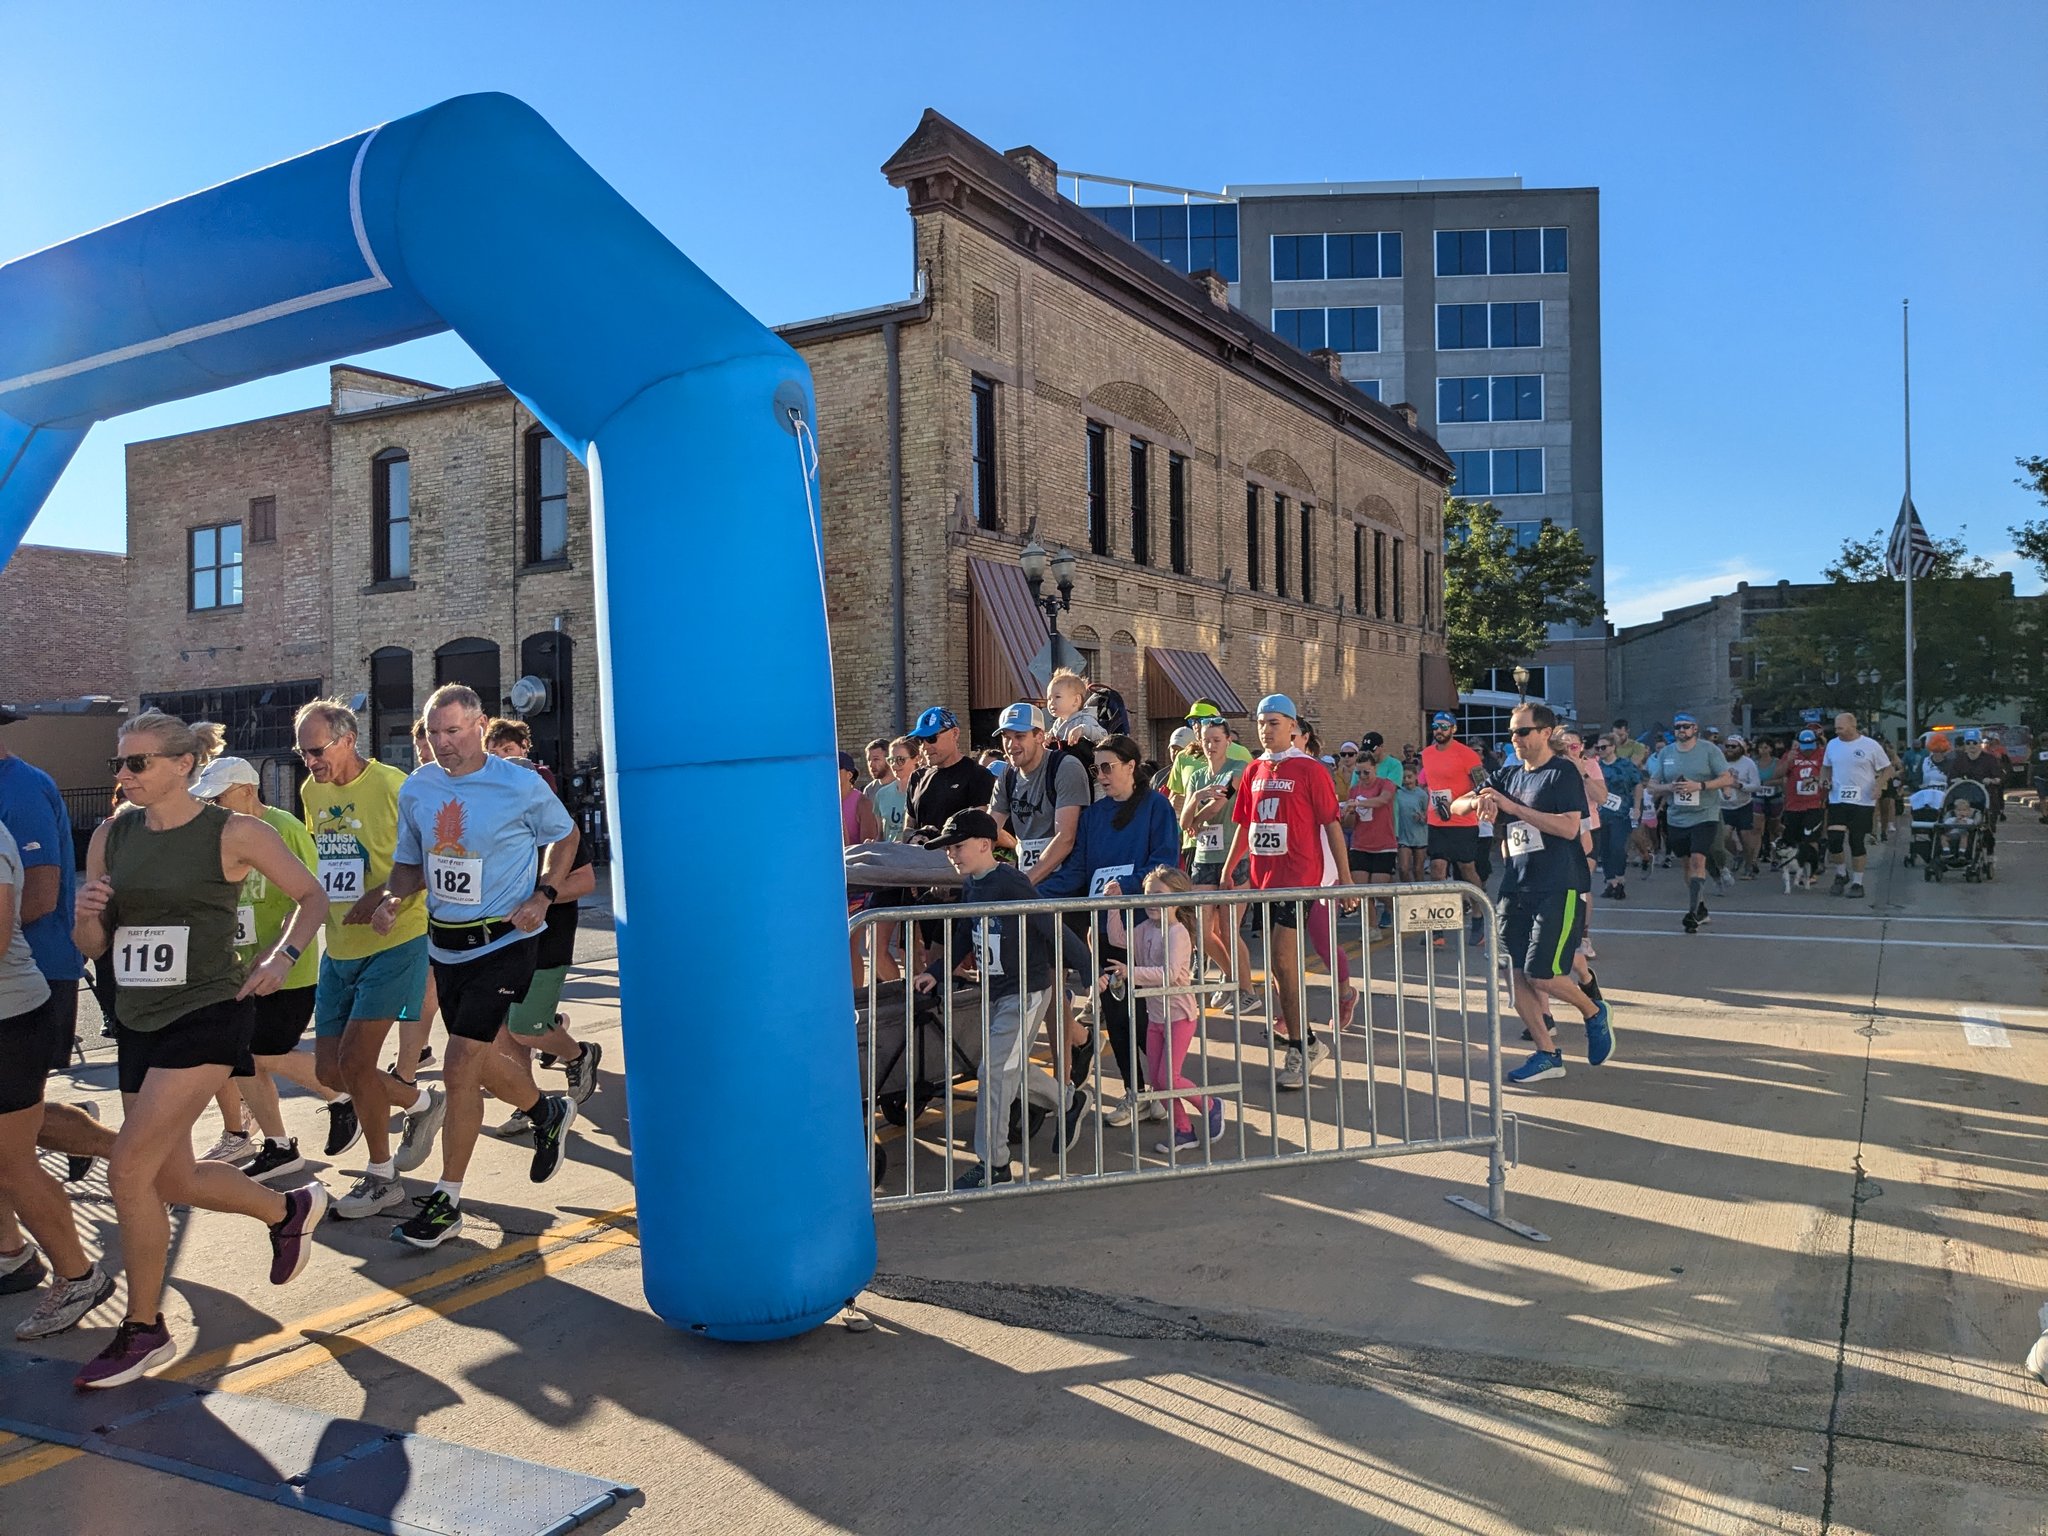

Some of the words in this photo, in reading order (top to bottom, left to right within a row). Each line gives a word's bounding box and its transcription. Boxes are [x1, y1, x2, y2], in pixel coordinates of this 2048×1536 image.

[1680, 791, 1692, 801] 52
[1841, 790, 1857, 798] 227
[1257, 797, 1280, 822] W
[1254, 832, 1281, 848] 225
[1512, 829, 1530, 847] 84
[1022, 849, 1041, 867] 25
[323, 871, 356, 892] 142
[434, 868, 471, 894] 182
[1409, 907, 1455, 920] SNCO
[122, 943, 174, 972] 119
